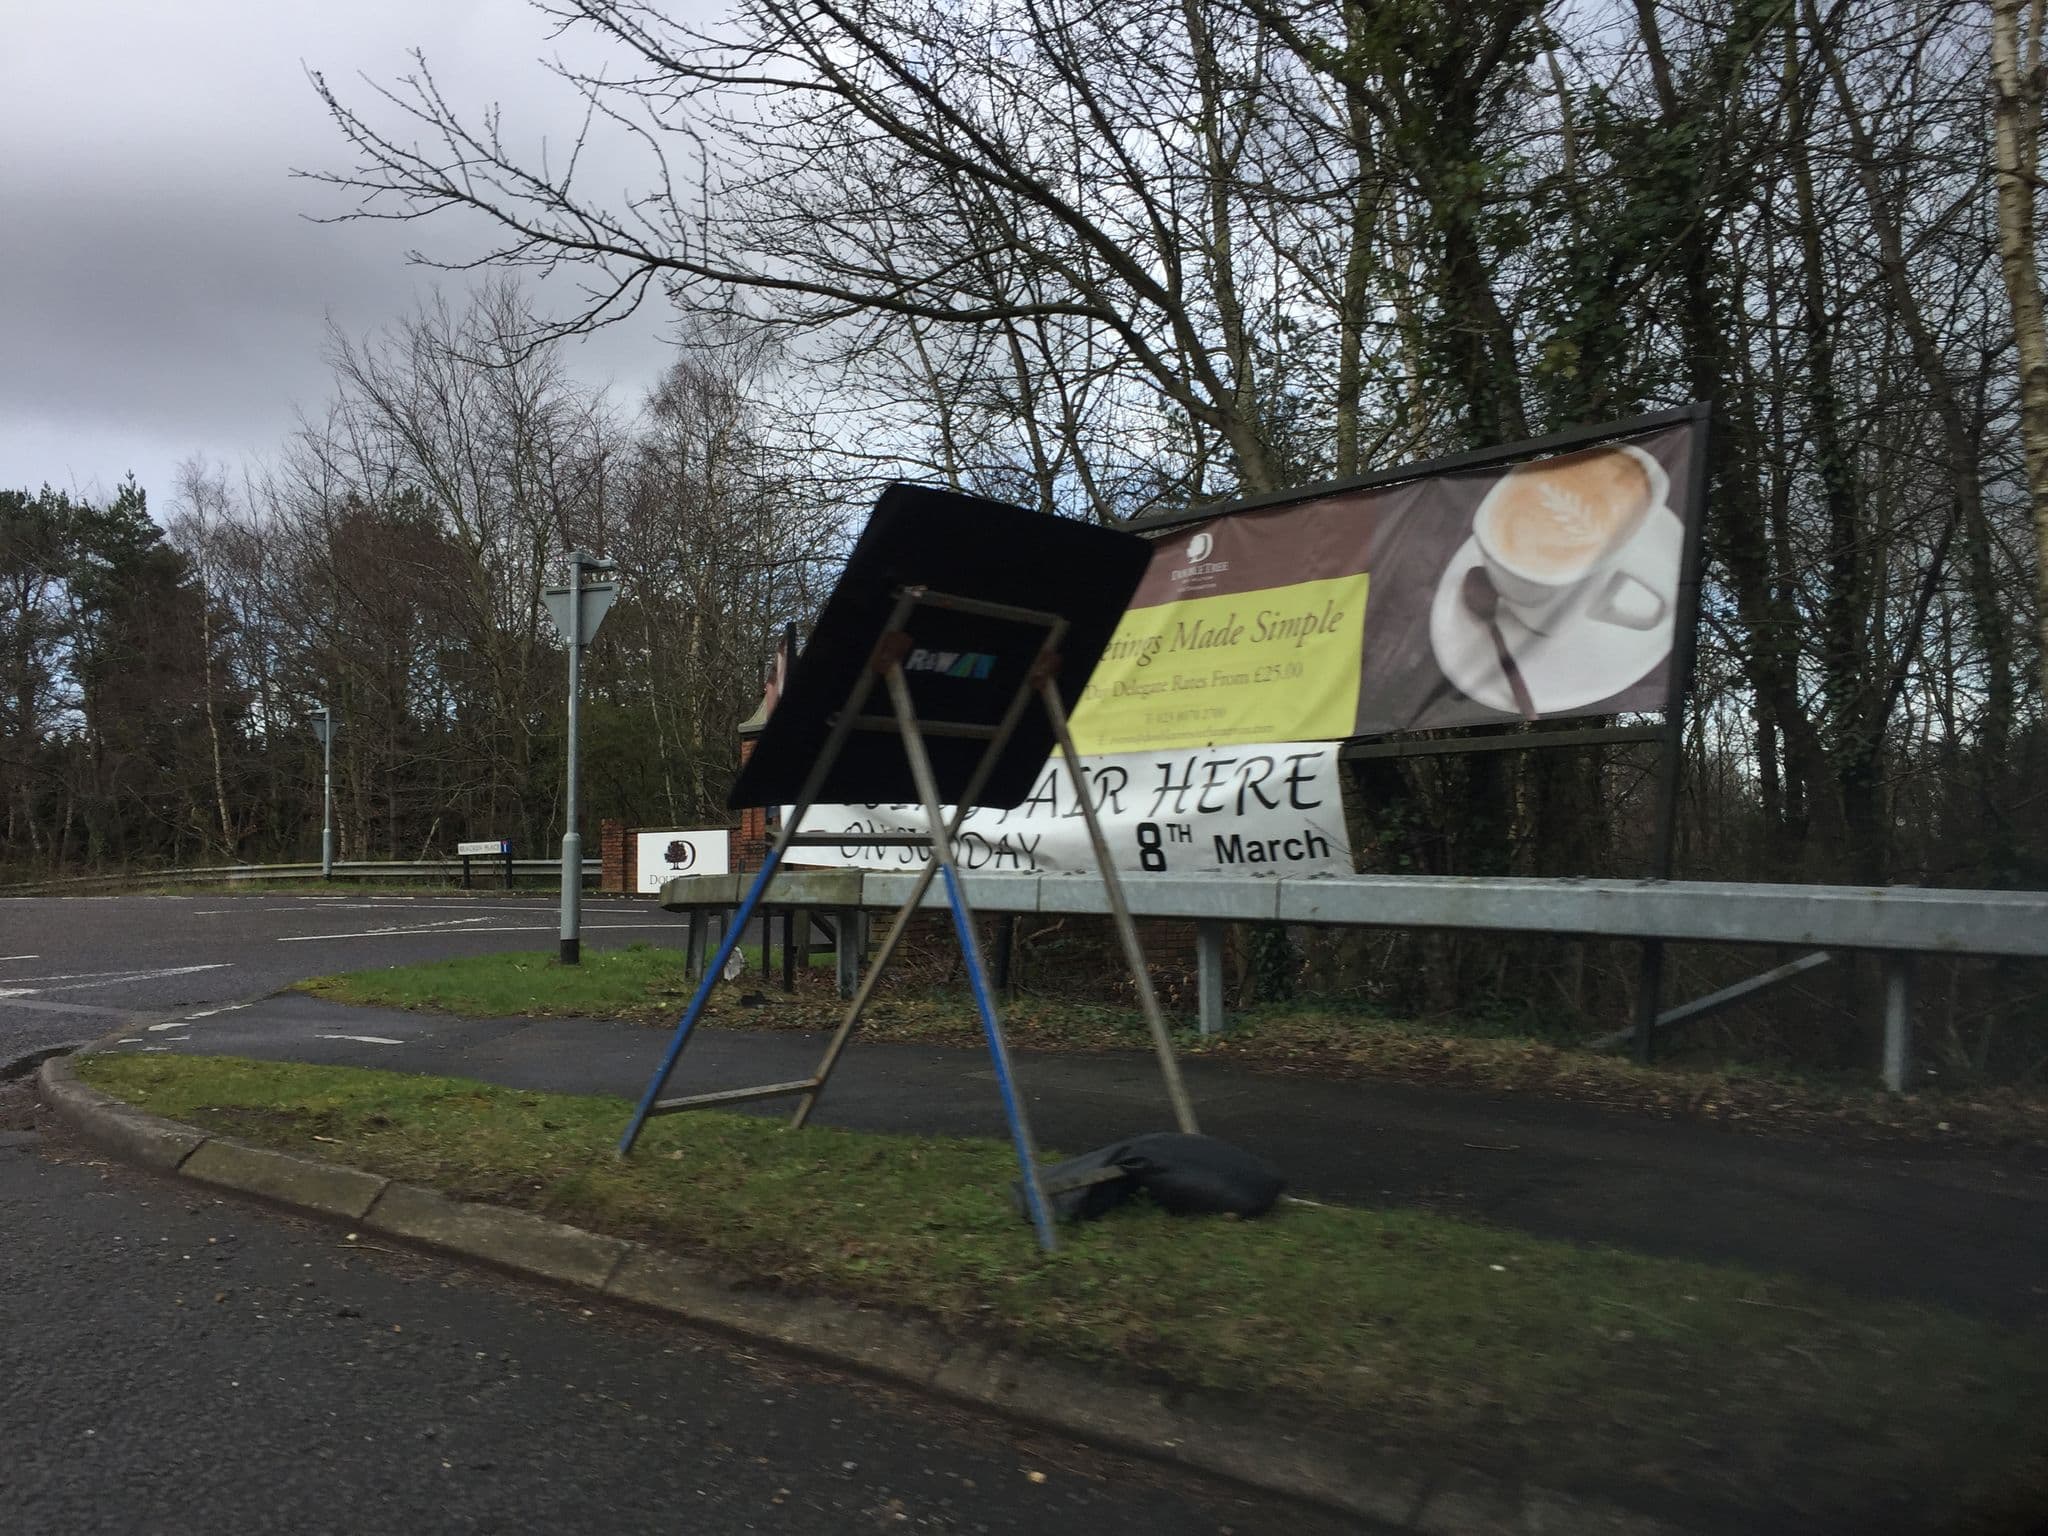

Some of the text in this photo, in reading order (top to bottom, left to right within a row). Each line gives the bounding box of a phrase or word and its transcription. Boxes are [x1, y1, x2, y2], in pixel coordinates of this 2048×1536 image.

[1169, 612, 1245, 652] Made
[1251, 600, 1345, 648] Simple
[1148, 751, 1324, 818] HERE
[1213, 829, 1331, 865] March
